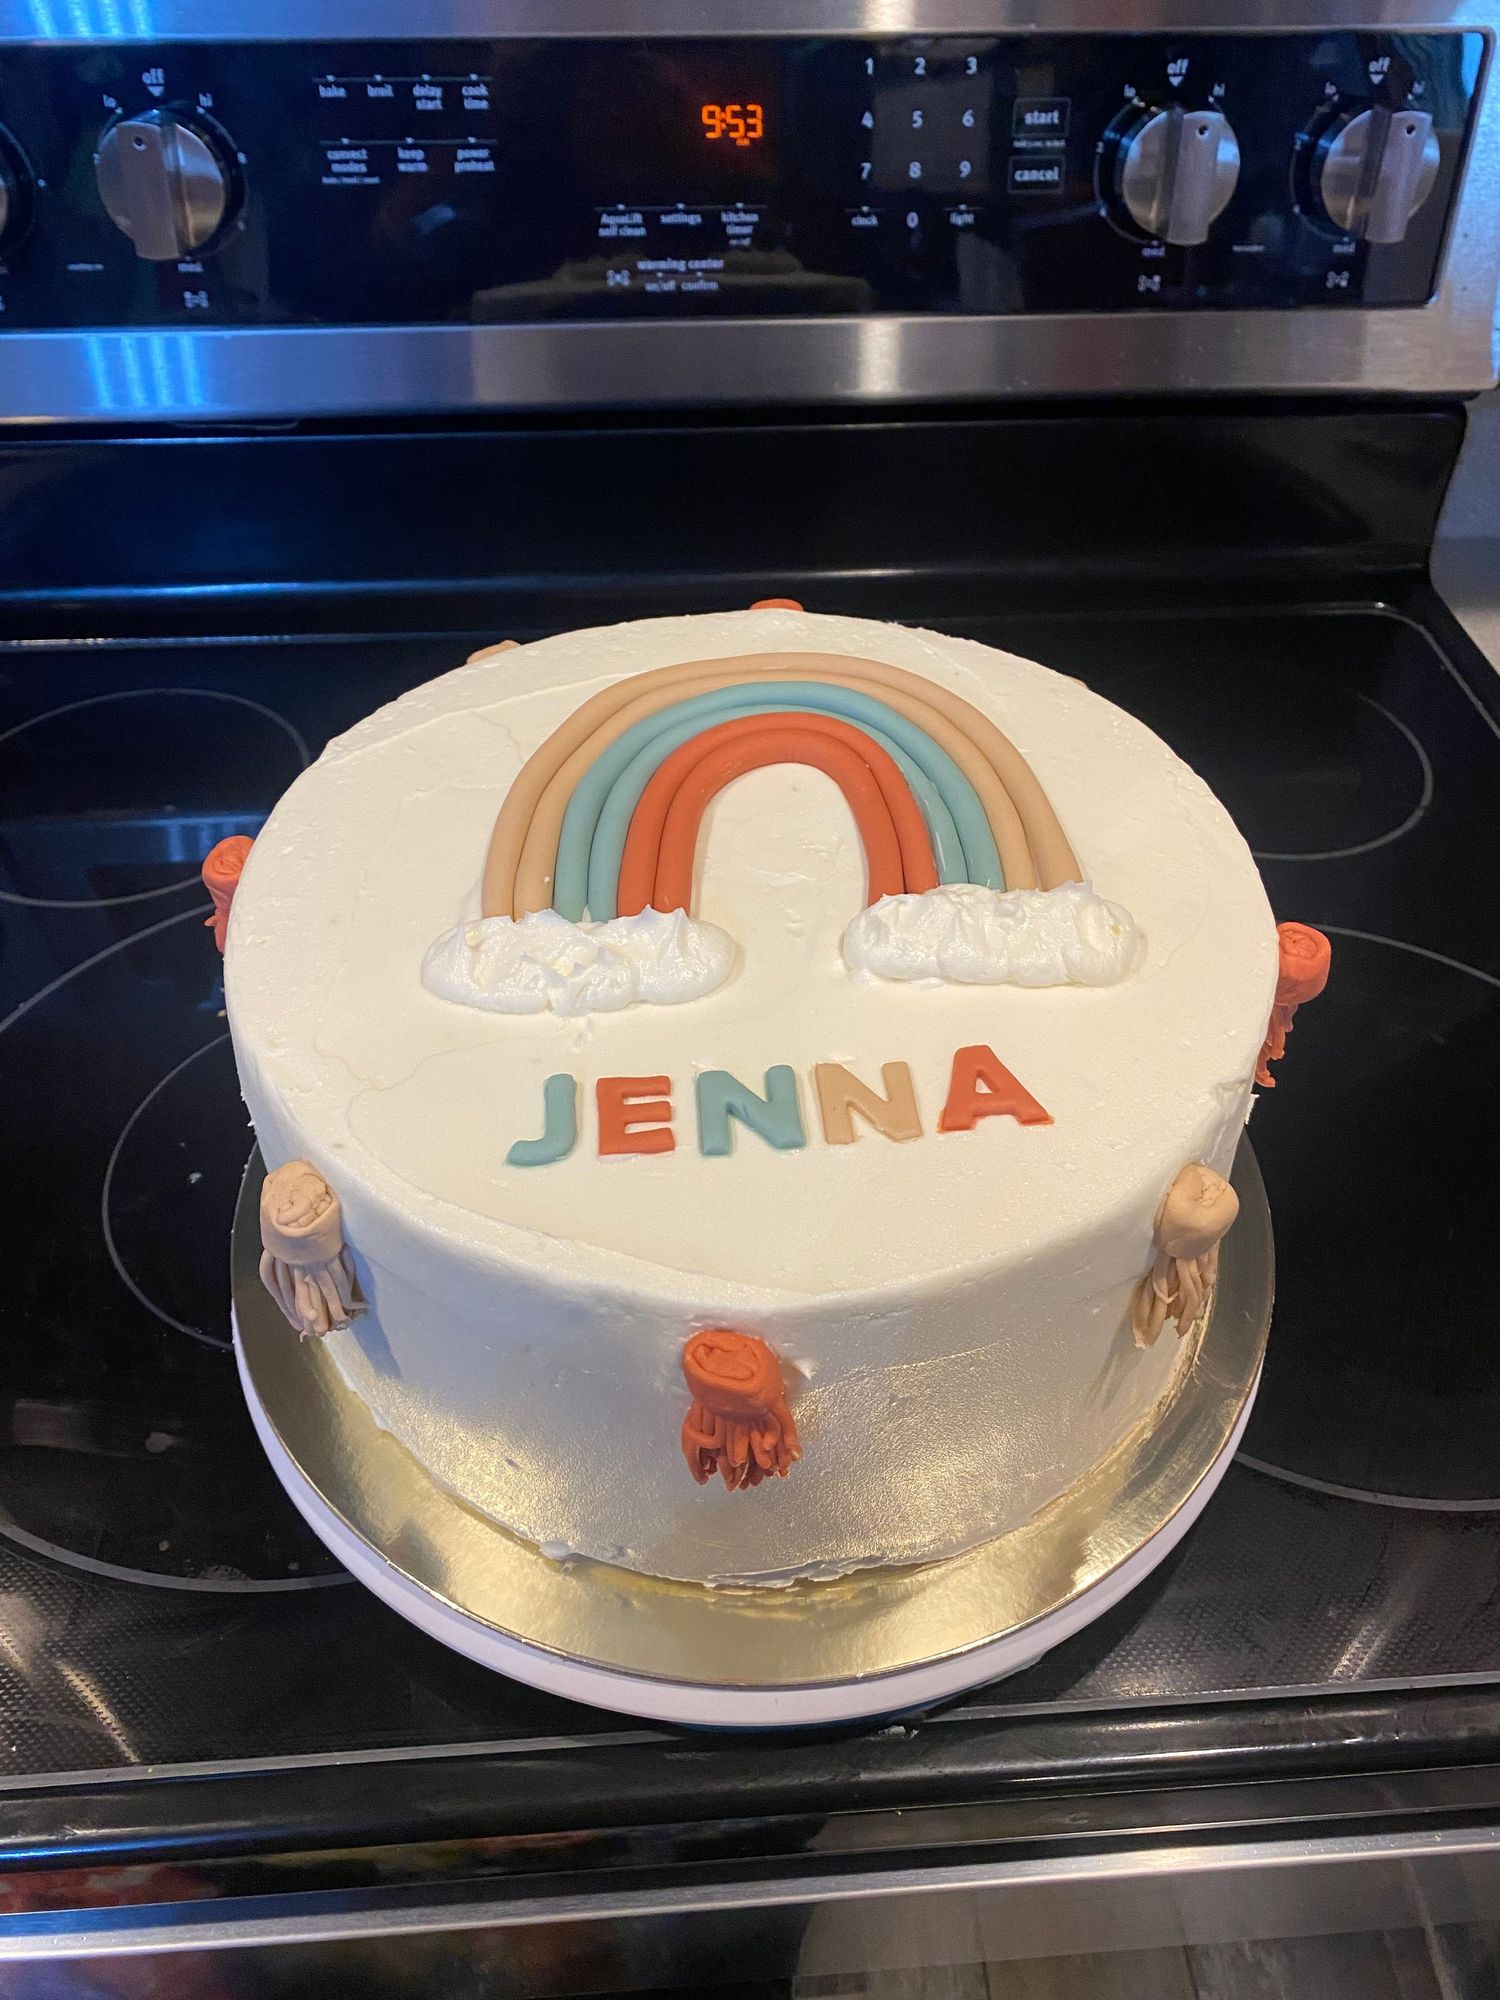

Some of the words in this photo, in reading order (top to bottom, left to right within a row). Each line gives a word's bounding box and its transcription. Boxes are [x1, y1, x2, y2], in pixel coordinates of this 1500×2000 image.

[865, 57, 874, 75] 1
[914, 57, 926, 75] 2
[965, 56, 978, 75] 3
[701, 104, 763, 138] 9:53
[861, 110, 874, 128] 4
[912, 110, 923, 128] 5
[962, 109, 975, 127] 6
[860, 162, 872, 180] 7
[908, 161, 922, 179] 8
[959, 160, 971, 178] 9
[906, 211, 919, 229] 0
[505, 1043, 1055, 1167] JENNA
